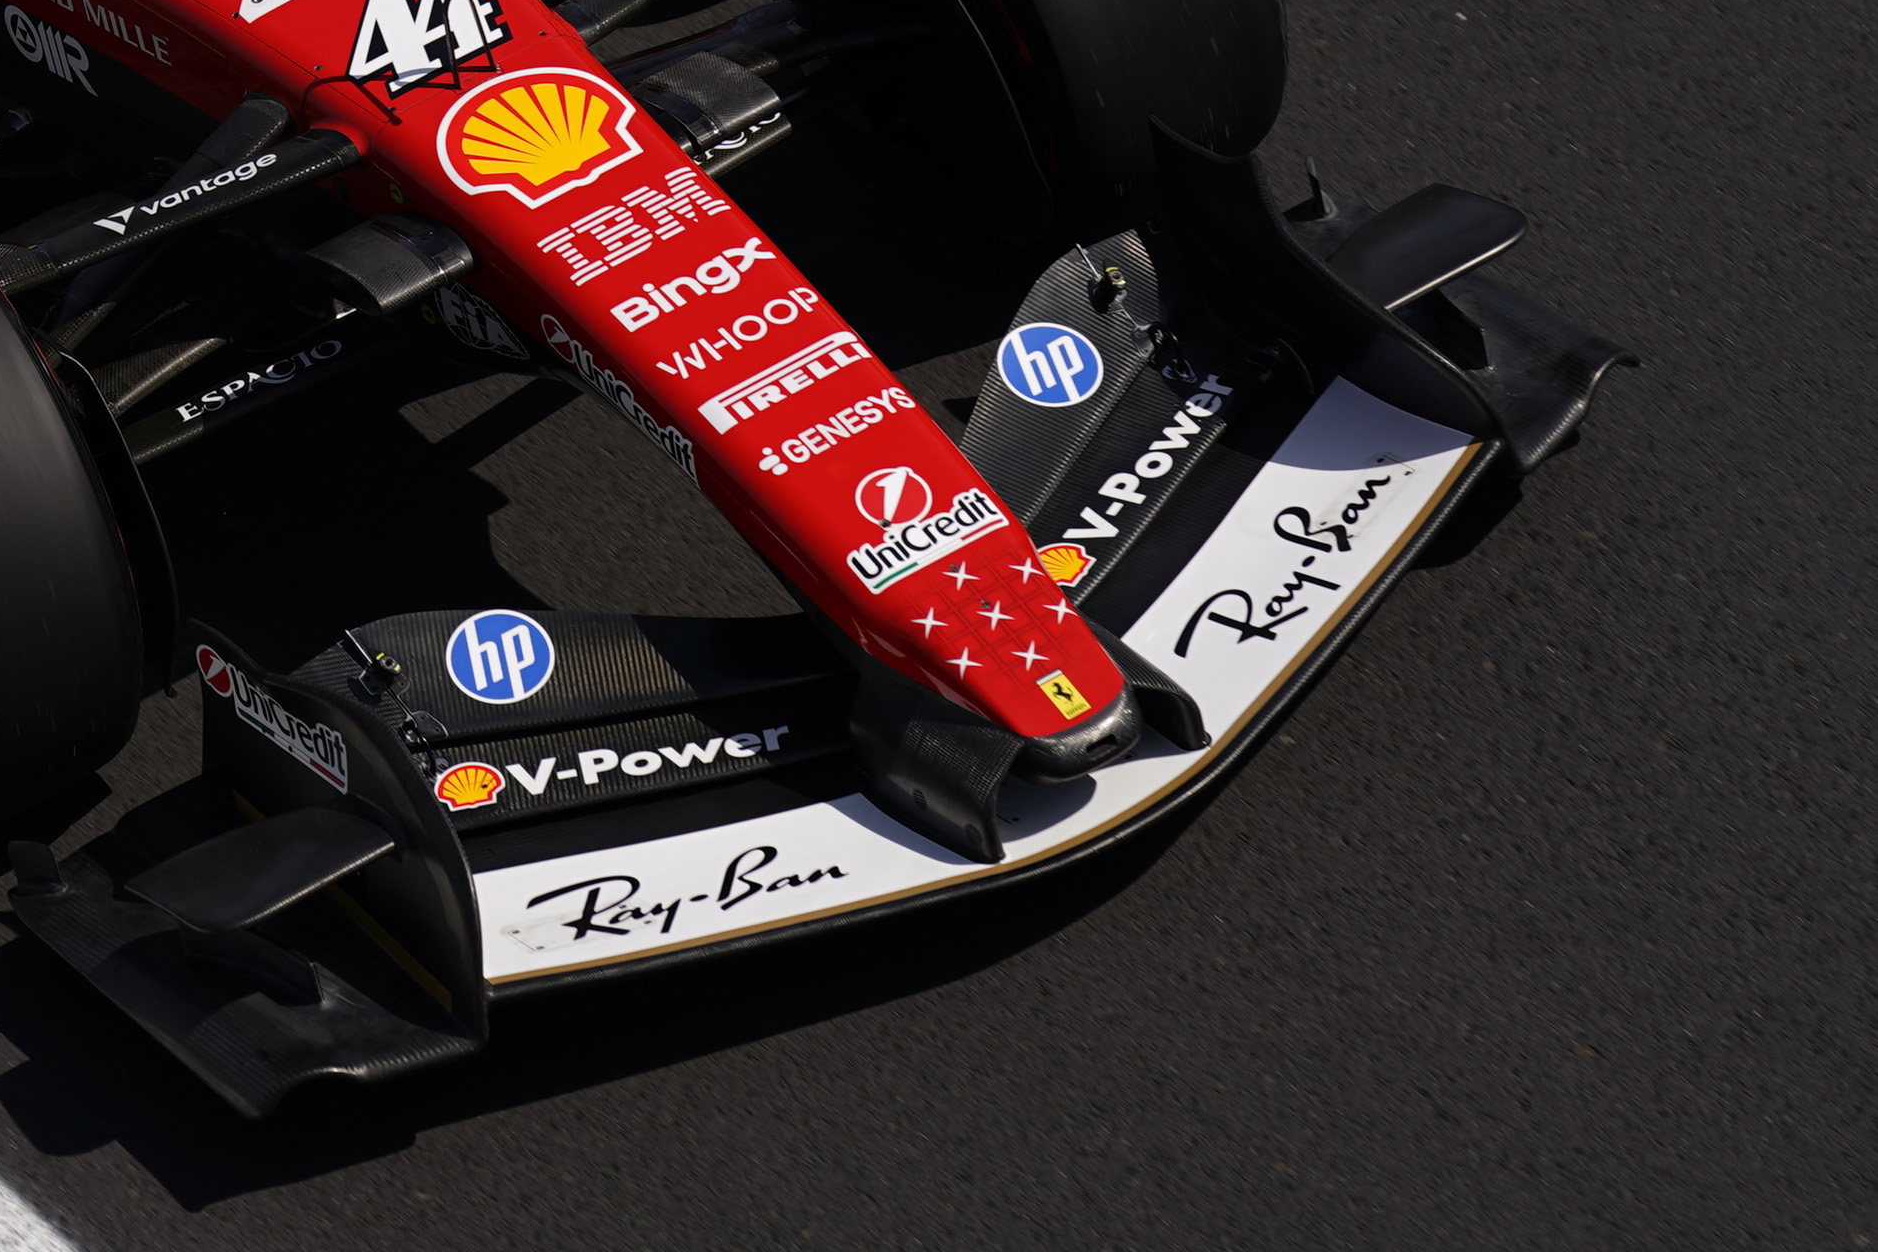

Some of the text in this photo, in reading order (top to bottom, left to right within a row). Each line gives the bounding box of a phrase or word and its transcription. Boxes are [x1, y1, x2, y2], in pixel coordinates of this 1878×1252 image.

[139, 152, 278, 216] vantage
[537, 166, 731, 287] IBM
[175, 338, 343, 422] ESPACIO
[655, 287, 819, 379] WHOOP
[1005, 323, 1092, 406] hp
[570, 338, 695, 478] UniCredit
[697, 330, 872, 435] PIRELLI
[780, 386, 917, 464] GENESYS
[850, 489, 999, 583] UniCredit
[1173, 473, 1393, 659] Ray-Ban
[456, 610, 542, 703] hp
[233, 664, 347, 777] UniCredit
[526, 845, 850, 941] Ray-Ban
